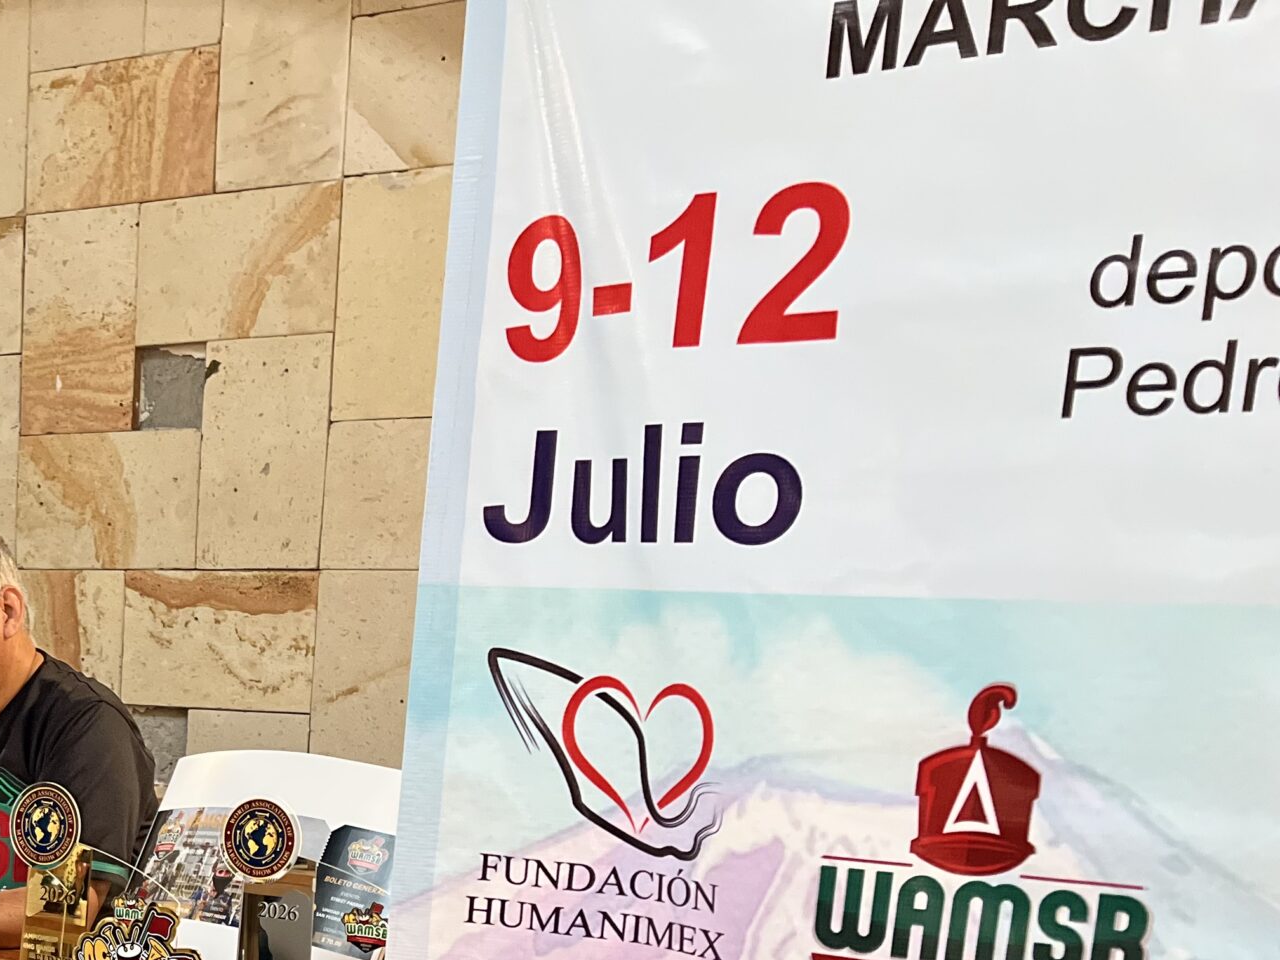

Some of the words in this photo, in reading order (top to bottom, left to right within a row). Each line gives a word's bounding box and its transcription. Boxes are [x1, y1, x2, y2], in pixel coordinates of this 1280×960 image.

[825, 0, 1265, 79] MARC
[505, 181, 851, 363] 9-12
[1061, 339, 1280, 419] Pedr
[483, 422, 803, 545] Julio
[229, 803, 250, 824] WORLD
[252, 801, 290, 826] ASSOCIATION
[287, 826, 293, 836] OF
[226, 841, 251, 874] MARCHING
[273, 851, 291, 871] BANDS
[40, 885, 77, 905] 2026
[324, 875, 352, 887] BOLETO
[477, 852, 719, 914] FUNDACIÓN
[258, 901, 299, 921] 2026
[346, 924, 388, 939] WAMSB
